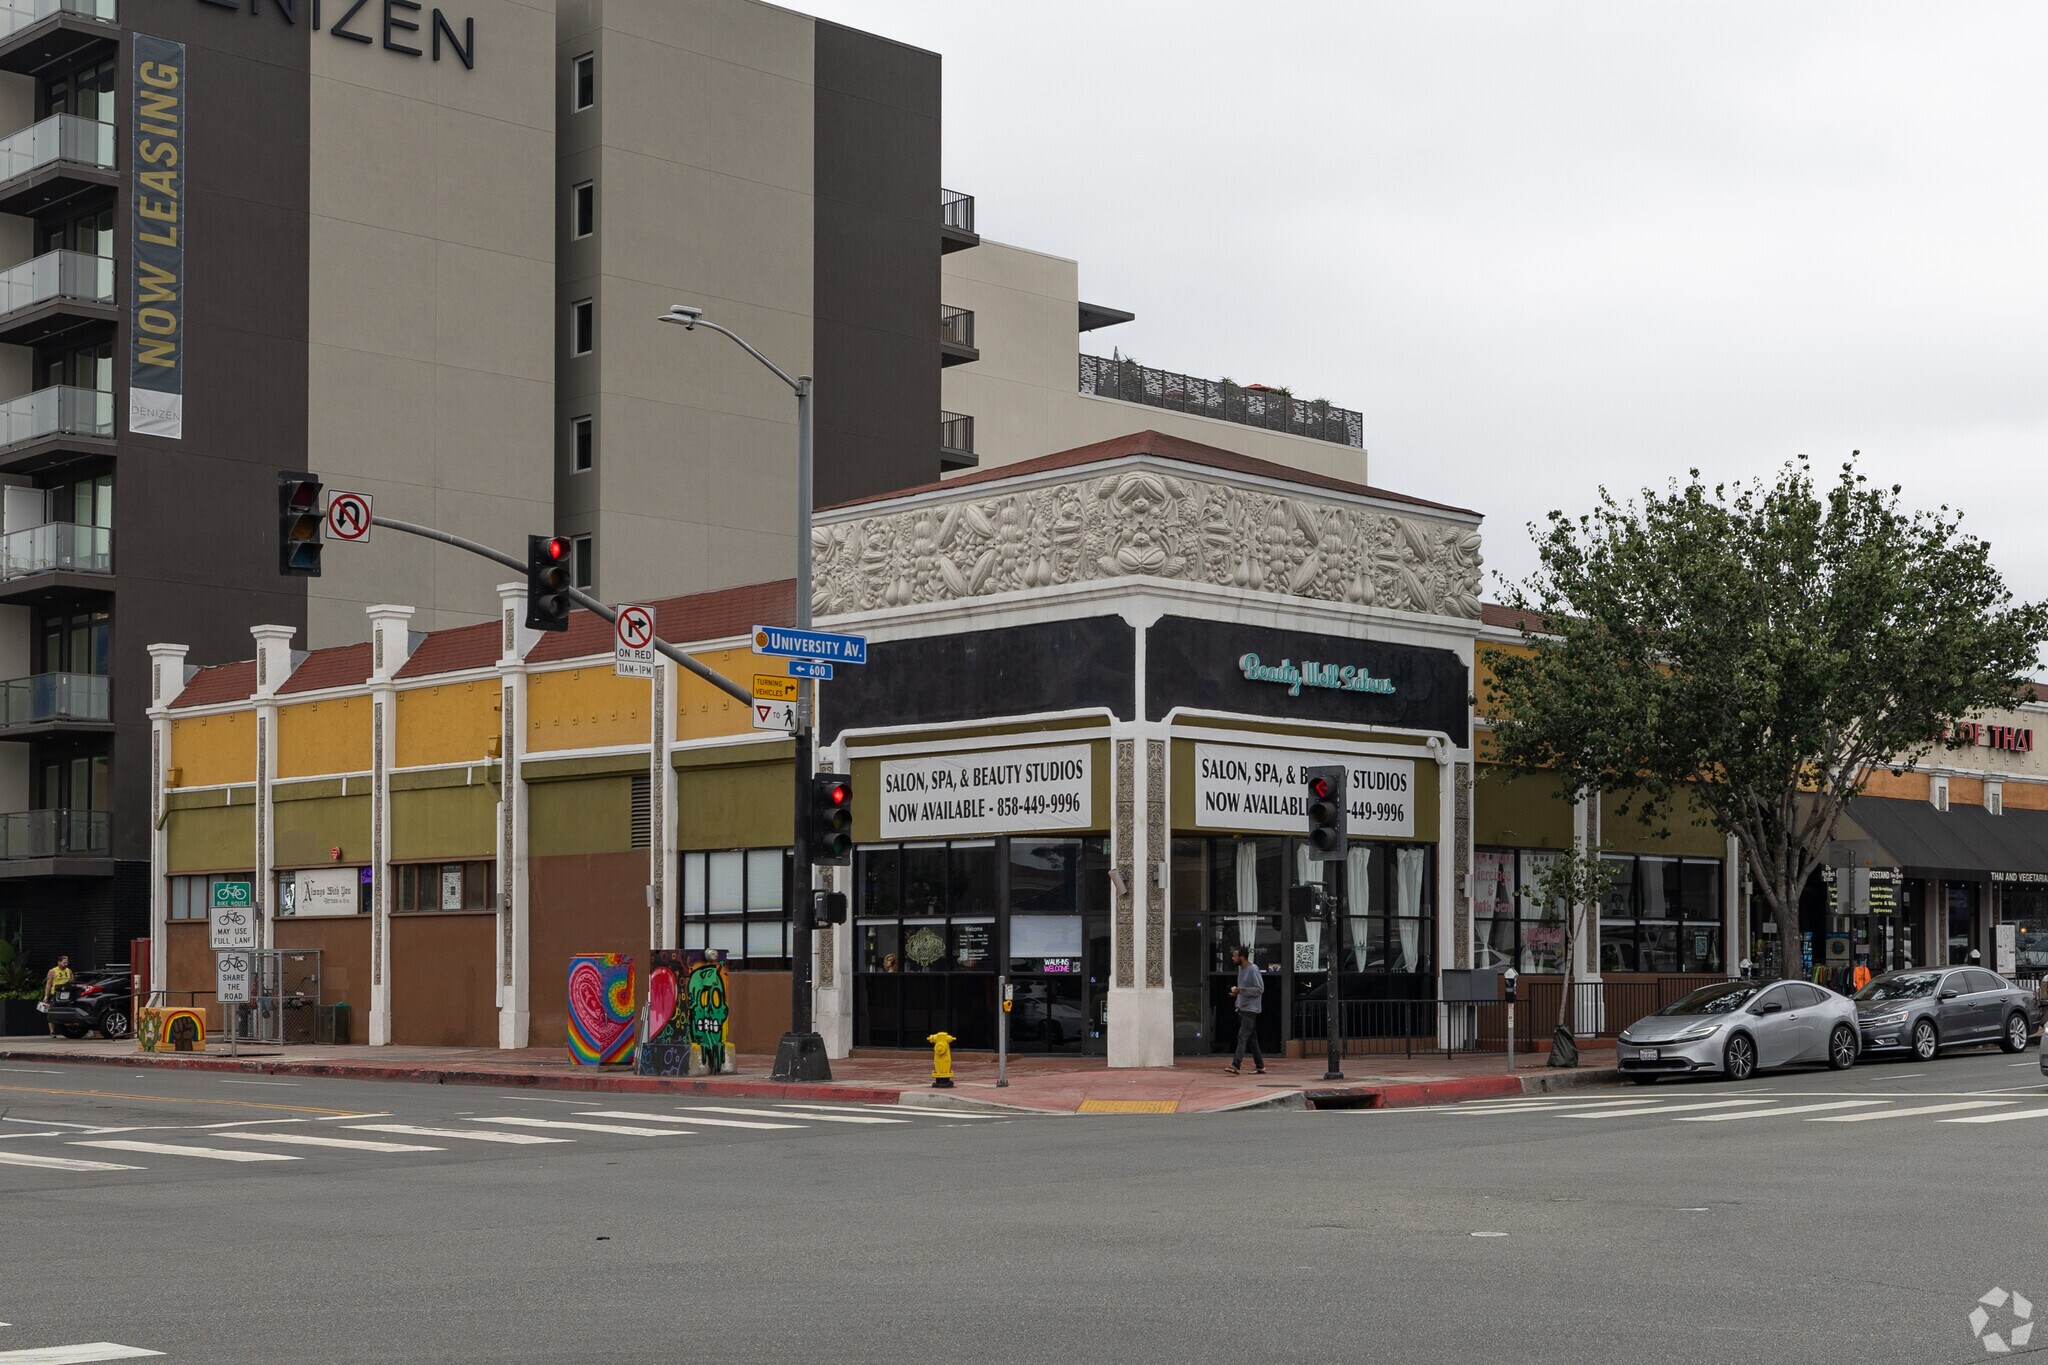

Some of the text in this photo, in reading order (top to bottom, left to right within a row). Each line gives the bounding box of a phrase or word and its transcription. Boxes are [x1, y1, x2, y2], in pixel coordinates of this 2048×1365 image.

[196, 0, 474, 69] IZEN
[138, 60, 178, 368] NOW LEASING
[131, 405, 180, 421] DENIZEN
[619, 648, 651, 659] ON RED
[619, 663, 652, 675] 11AM-1PM
[809, 665, 826, 676] 600
[1239, 653, 1396, 696] Beauty Well Salons
[756, 688, 783, 697] VEHICLES
[757, 678, 783, 687] TURNING
[1992, 725, 2033, 751] THAI
[886, 759, 1083, 793] SALON, SPA, & BEAUTY STUDIOS
[1202, 758, 1251, 783] SALON,
[1254, 762, 1283, 787] SPA,
[1286, 765, 1296, 784] &
[1353, 769, 1407, 792] STUDIOS
[888, 803, 919, 823] NOW
[921, 799, 985, 821] AVAILABLE
[997, 792, 1080, 817] 858-449-9996
[1205, 791, 1241, 813] NOW
[1346, 801, 1404, 822] -449-9996
[1991, 872, 2005, 881] THAI
[2005, 872, 2018, 882] AND
